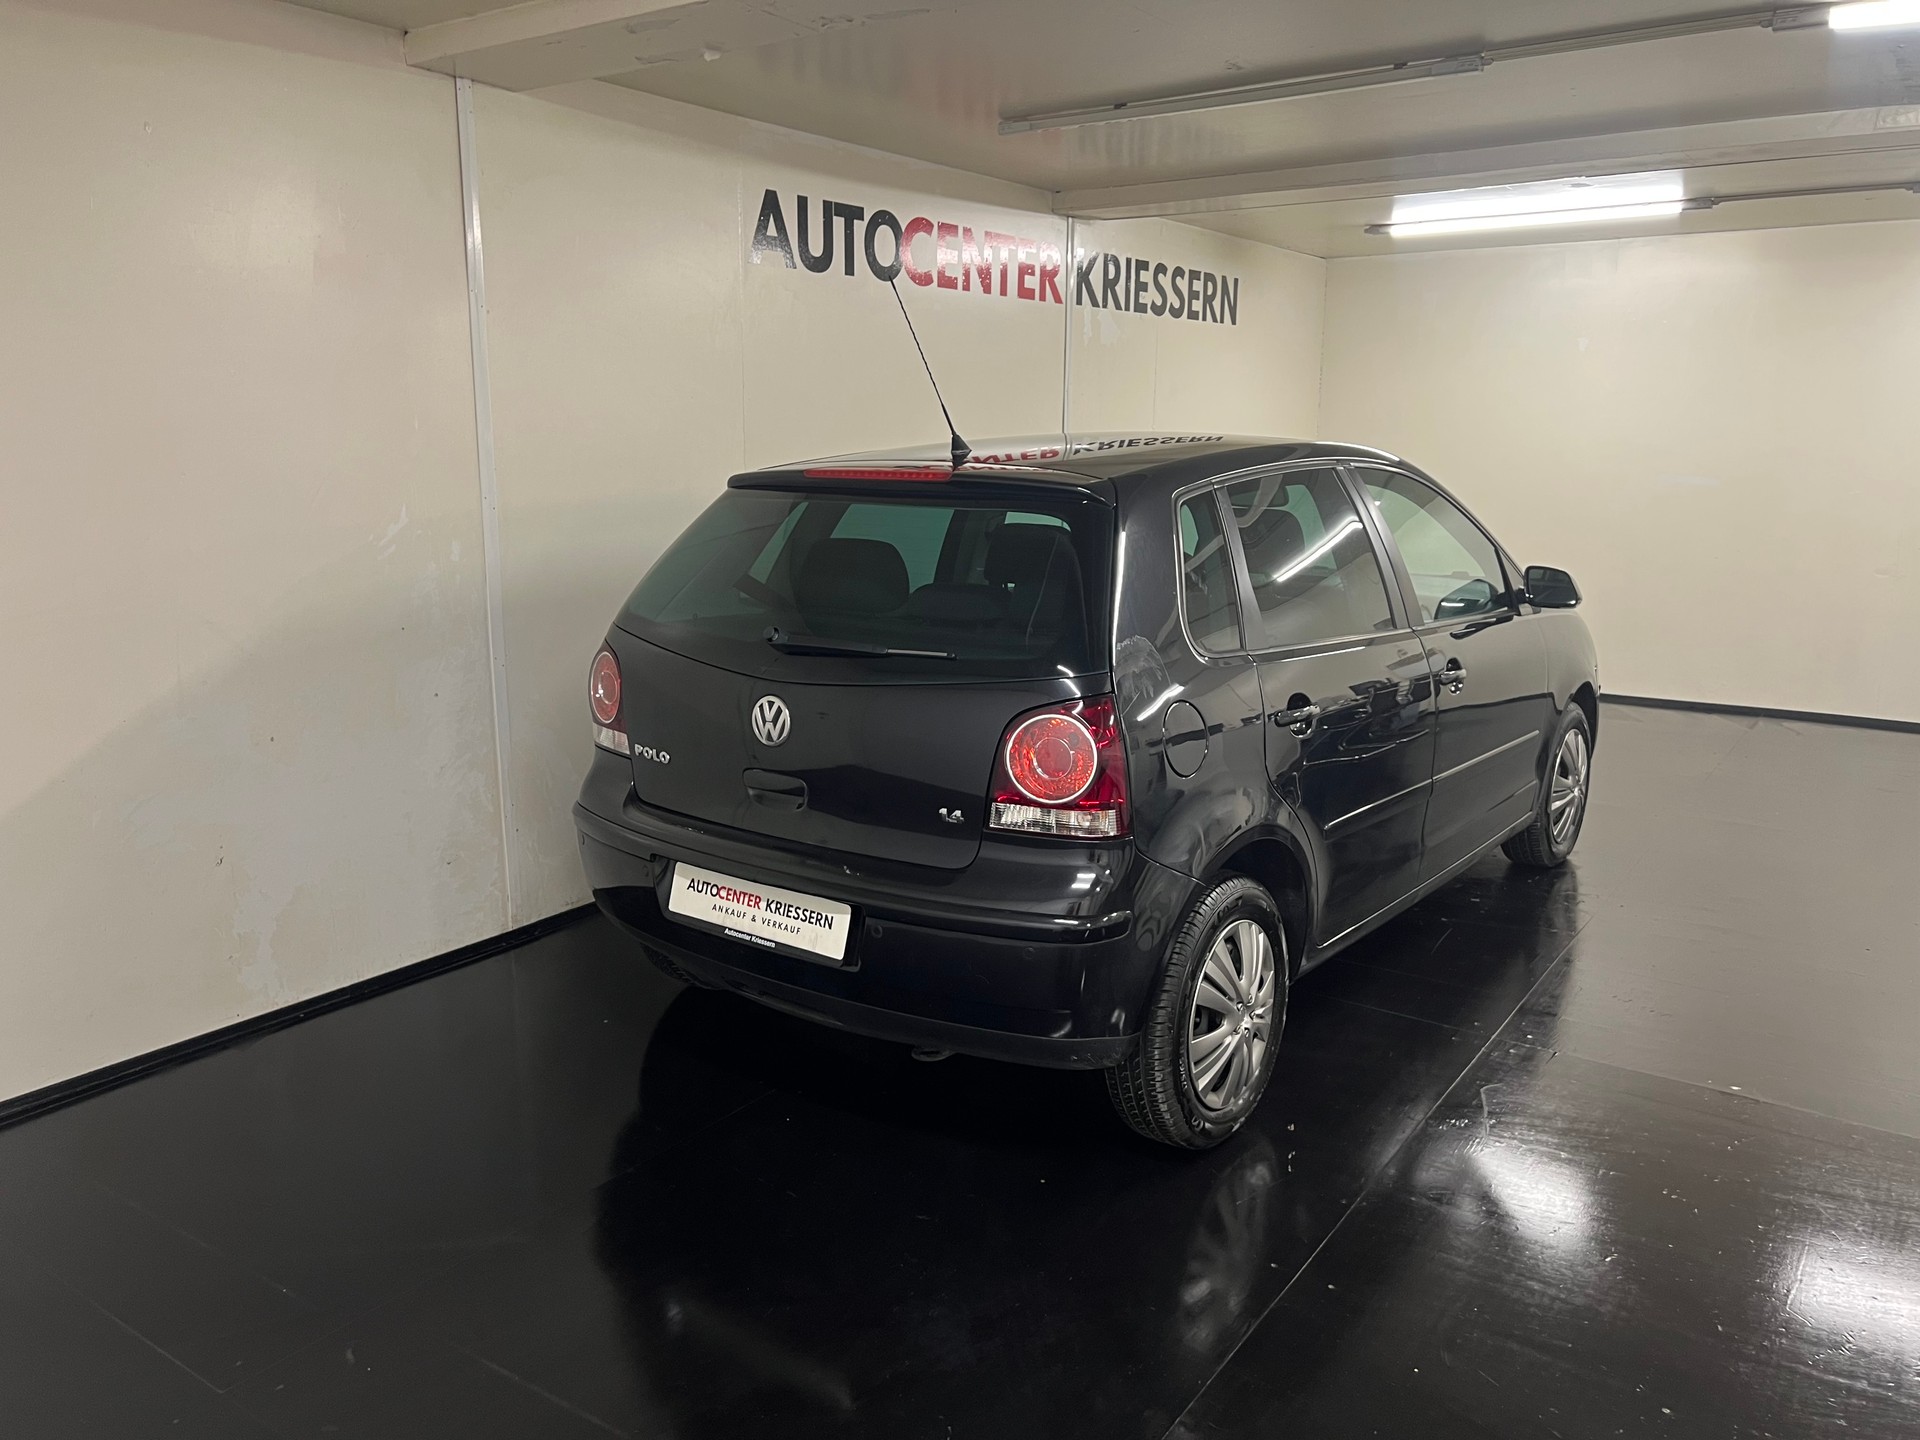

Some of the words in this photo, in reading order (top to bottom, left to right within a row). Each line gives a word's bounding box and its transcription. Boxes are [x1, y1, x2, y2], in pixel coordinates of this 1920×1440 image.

[748, 188, 1063, 305] AUTOCENTER
[1075, 250, 1239, 326] KRIESSERN
[751, 694, 791, 747] VW
[634, 743, 671, 764] POLO
[686, 878, 763, 910] AUTOCENTER
[764, 897, 834, 930] KRIESSERN
[711, 903, 747, 920] ANKAUF
[750, 914, 757, 923] &
[761, 917, 802, 935] VERKAUF
[724, 927, 751, 941] Autocenter
[751, 935, 776, 948] Kriessern
